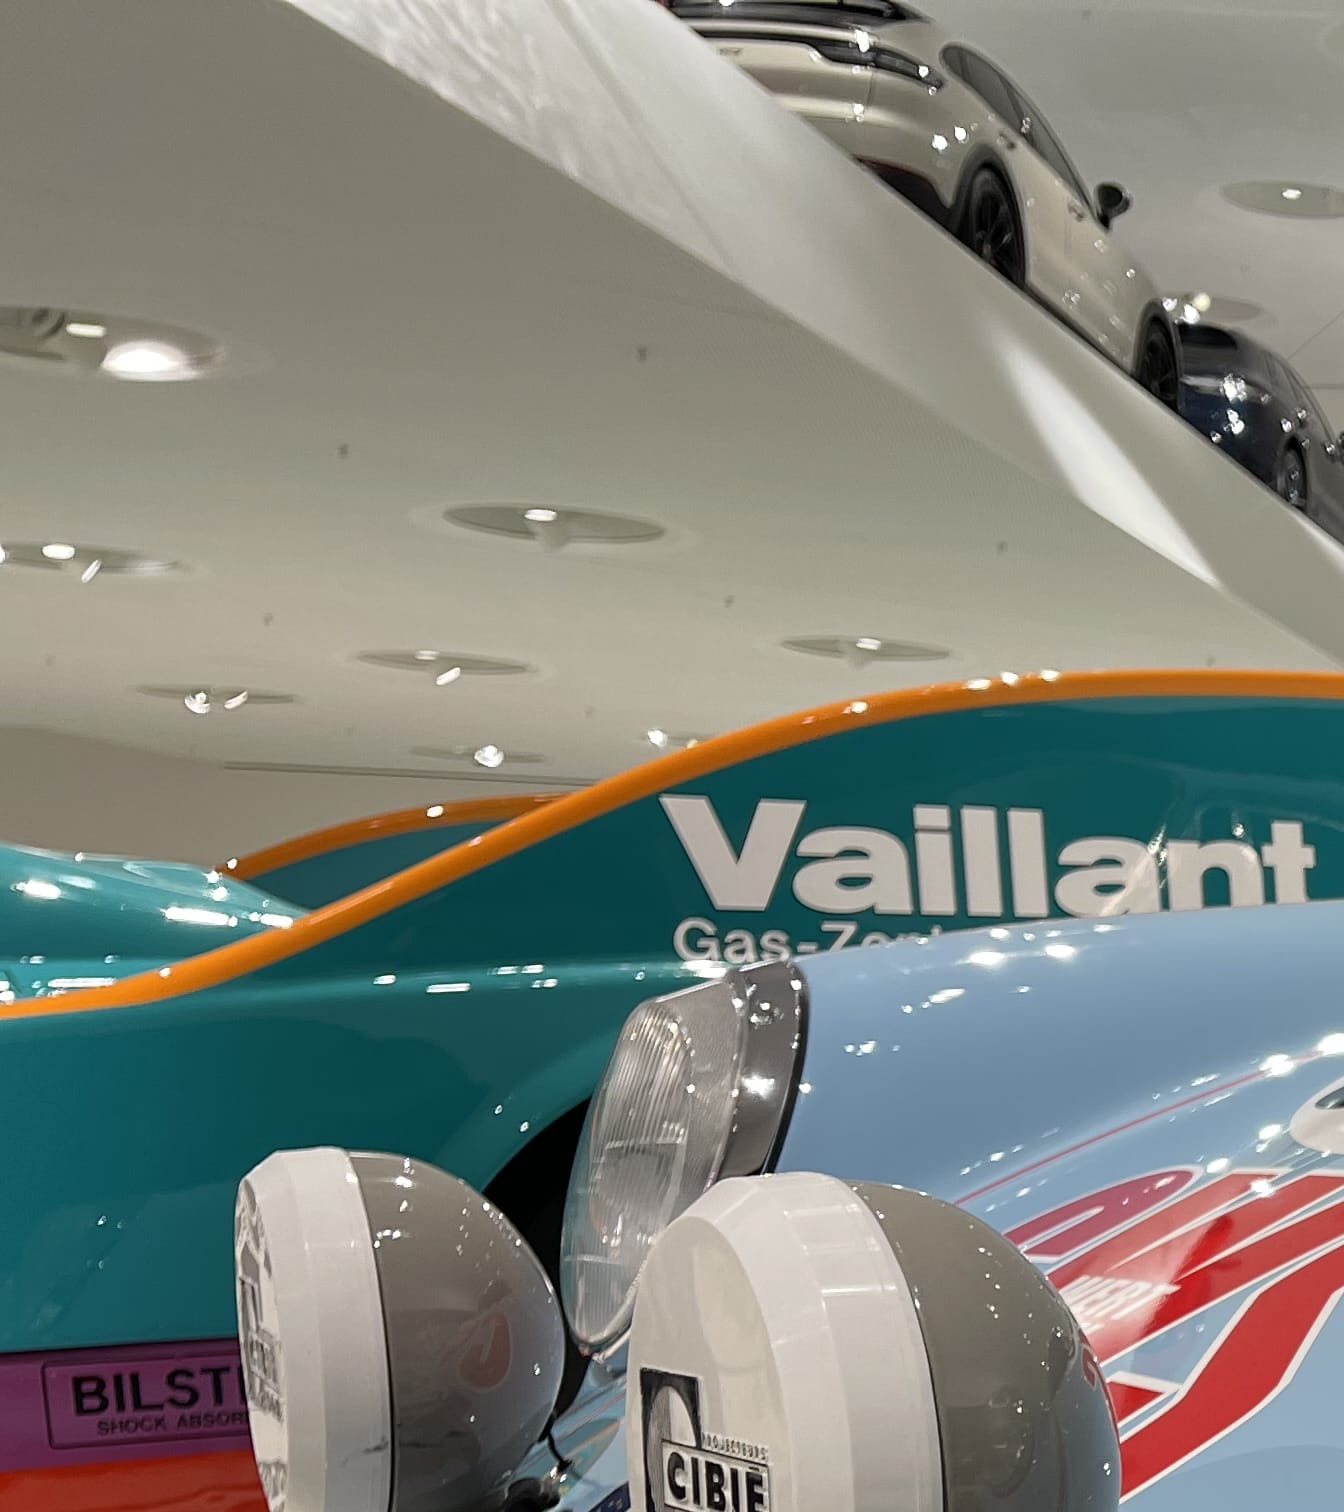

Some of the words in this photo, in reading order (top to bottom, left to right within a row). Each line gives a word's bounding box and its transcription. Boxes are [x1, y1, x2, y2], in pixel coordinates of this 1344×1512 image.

[659, 793, 1315, 918] Vaillant
[71, 1365, 248, 1417] BILST
[97, 1416, 168, 1436] SHOCK
[176, 1409, 251, 1429] ABSOR
